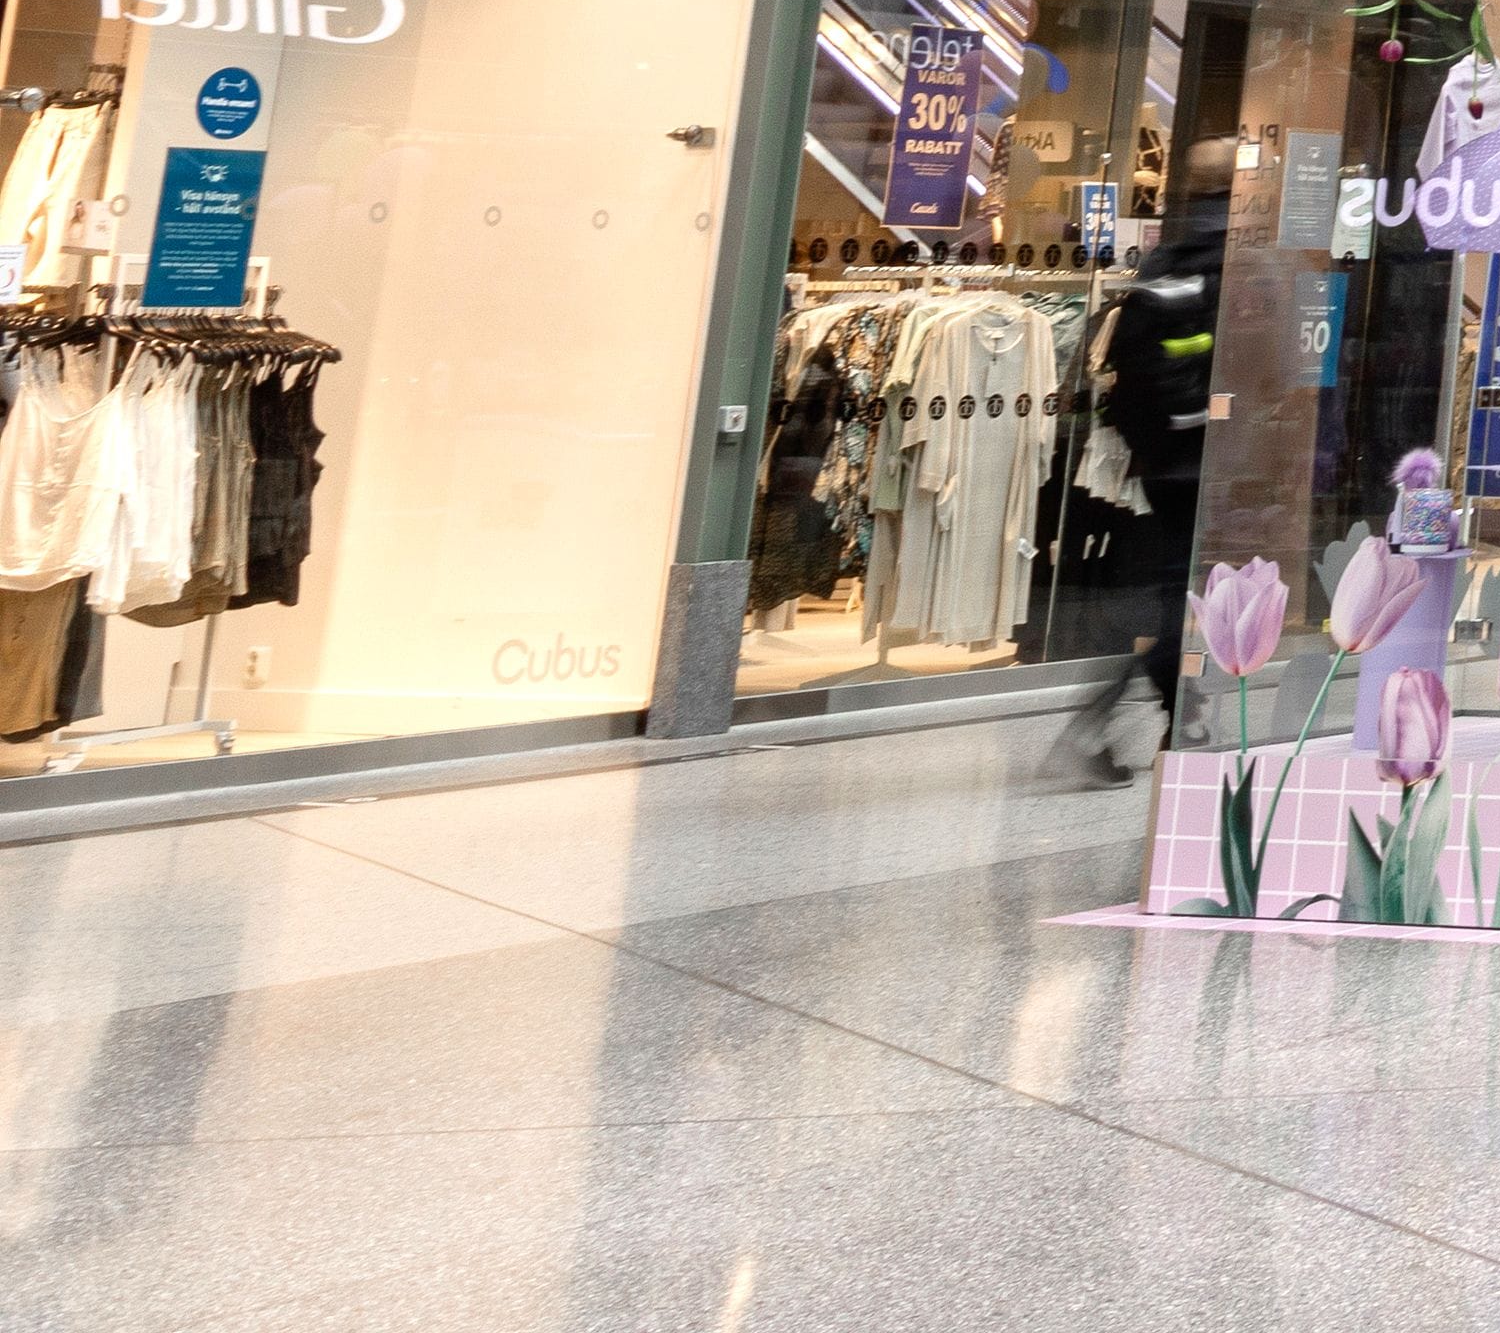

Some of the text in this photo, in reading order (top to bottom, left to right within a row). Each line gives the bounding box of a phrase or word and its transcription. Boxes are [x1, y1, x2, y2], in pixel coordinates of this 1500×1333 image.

[917, 69, 966, 86] VAROR
[907, 92, 967, 134] 30%
[904, 139, 964, 156] RABATT
[1299, 320, 1331, 353] 50
[491, 631, 622, 686] Cubus
